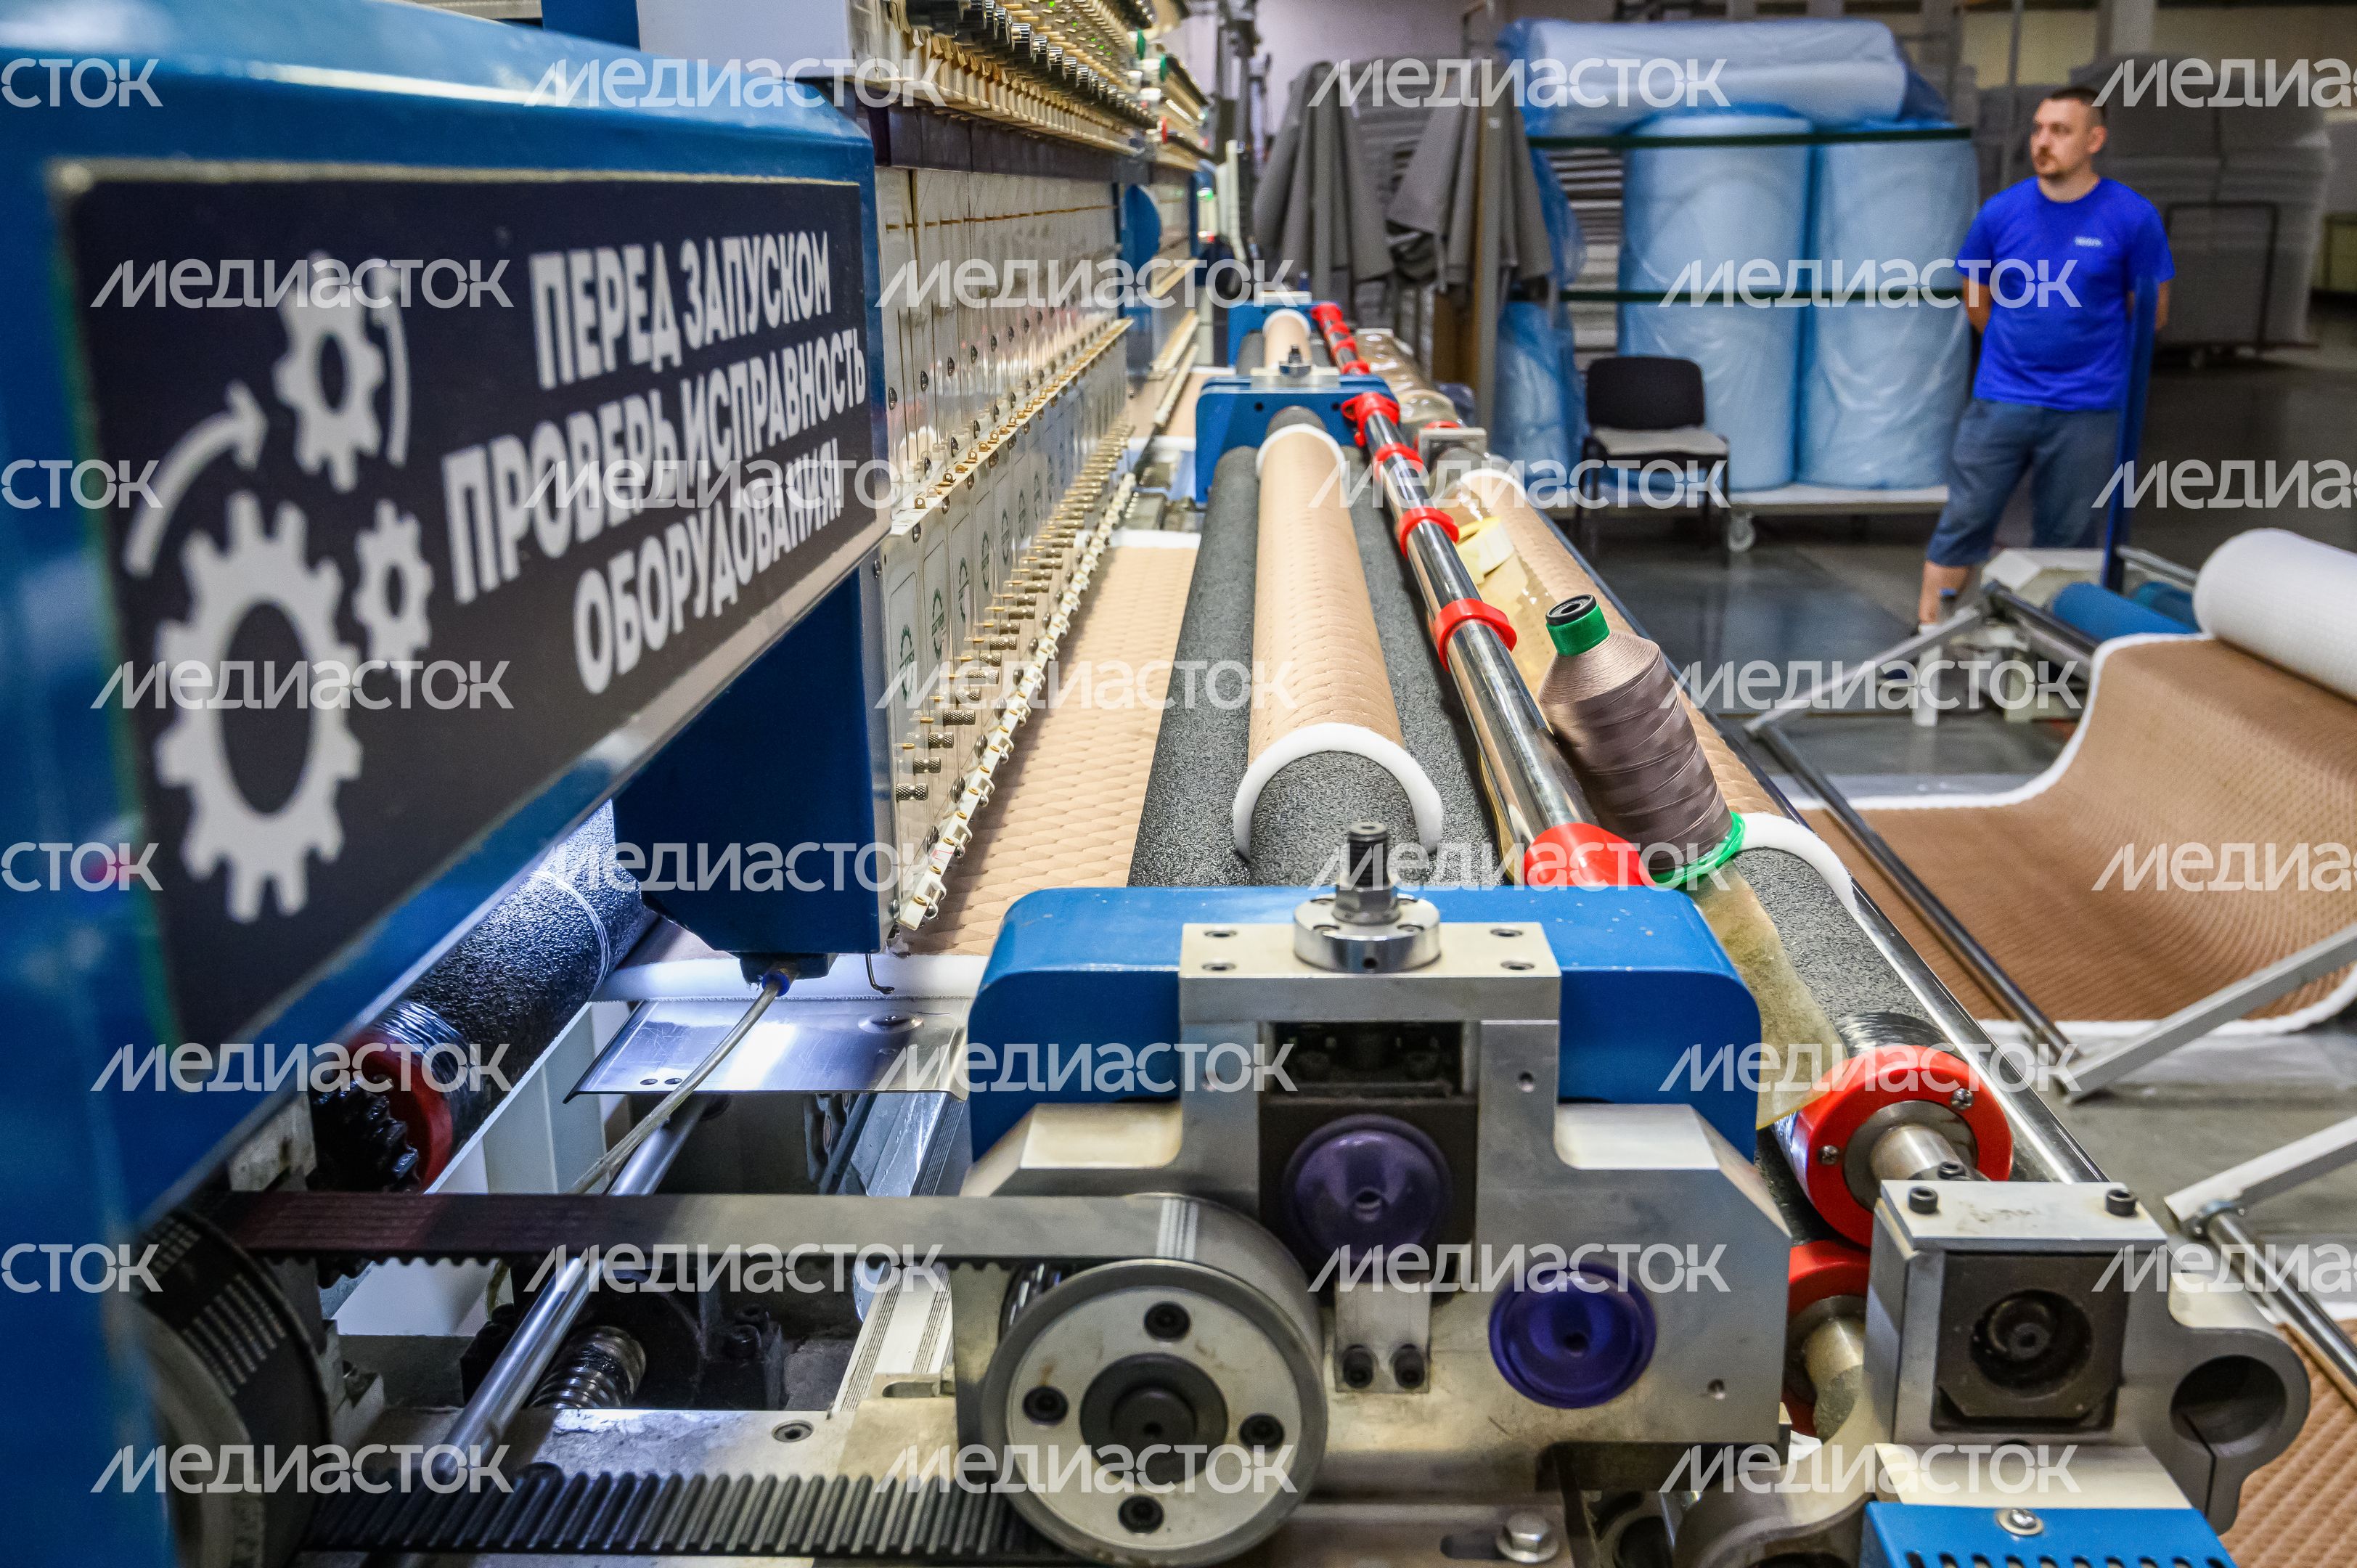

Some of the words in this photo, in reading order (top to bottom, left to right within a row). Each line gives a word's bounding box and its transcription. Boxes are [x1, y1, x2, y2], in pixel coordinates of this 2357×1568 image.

[529, 241, 681, 391] ПЕРЕД
[679, 231, 832, 349] ЗАПУСКОМ
[441, 389, 678, 604] ПРОВЕРЬ
[679, 327, 867, 487] ИСПРАВНОСТЬ
[573, 437, 842, 695] ОБОРУДОВАНИЯ!
